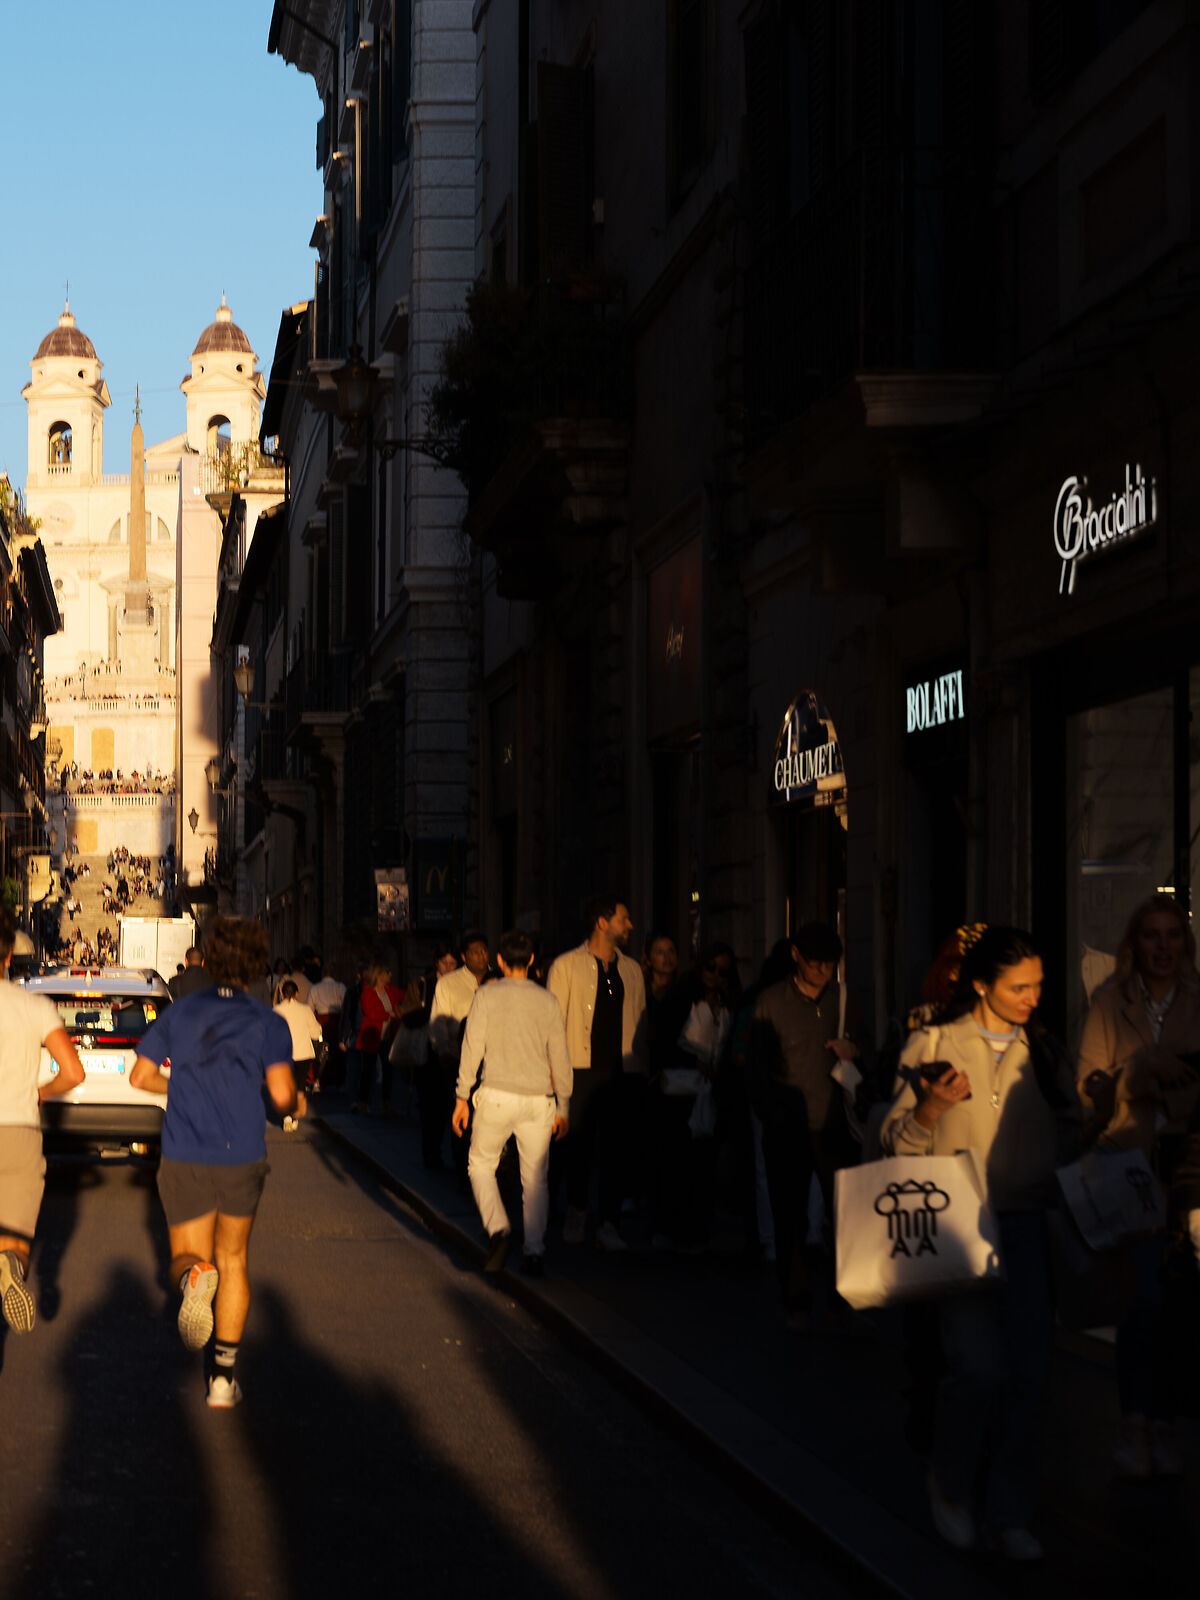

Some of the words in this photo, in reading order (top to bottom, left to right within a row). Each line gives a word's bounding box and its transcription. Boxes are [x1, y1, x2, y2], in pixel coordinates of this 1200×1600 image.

[1053, 462, 1157, 595] Braccialini
[906, 669, 965, 734] BOLAFFI
[774, 742, 838, 791] CHAUMET
